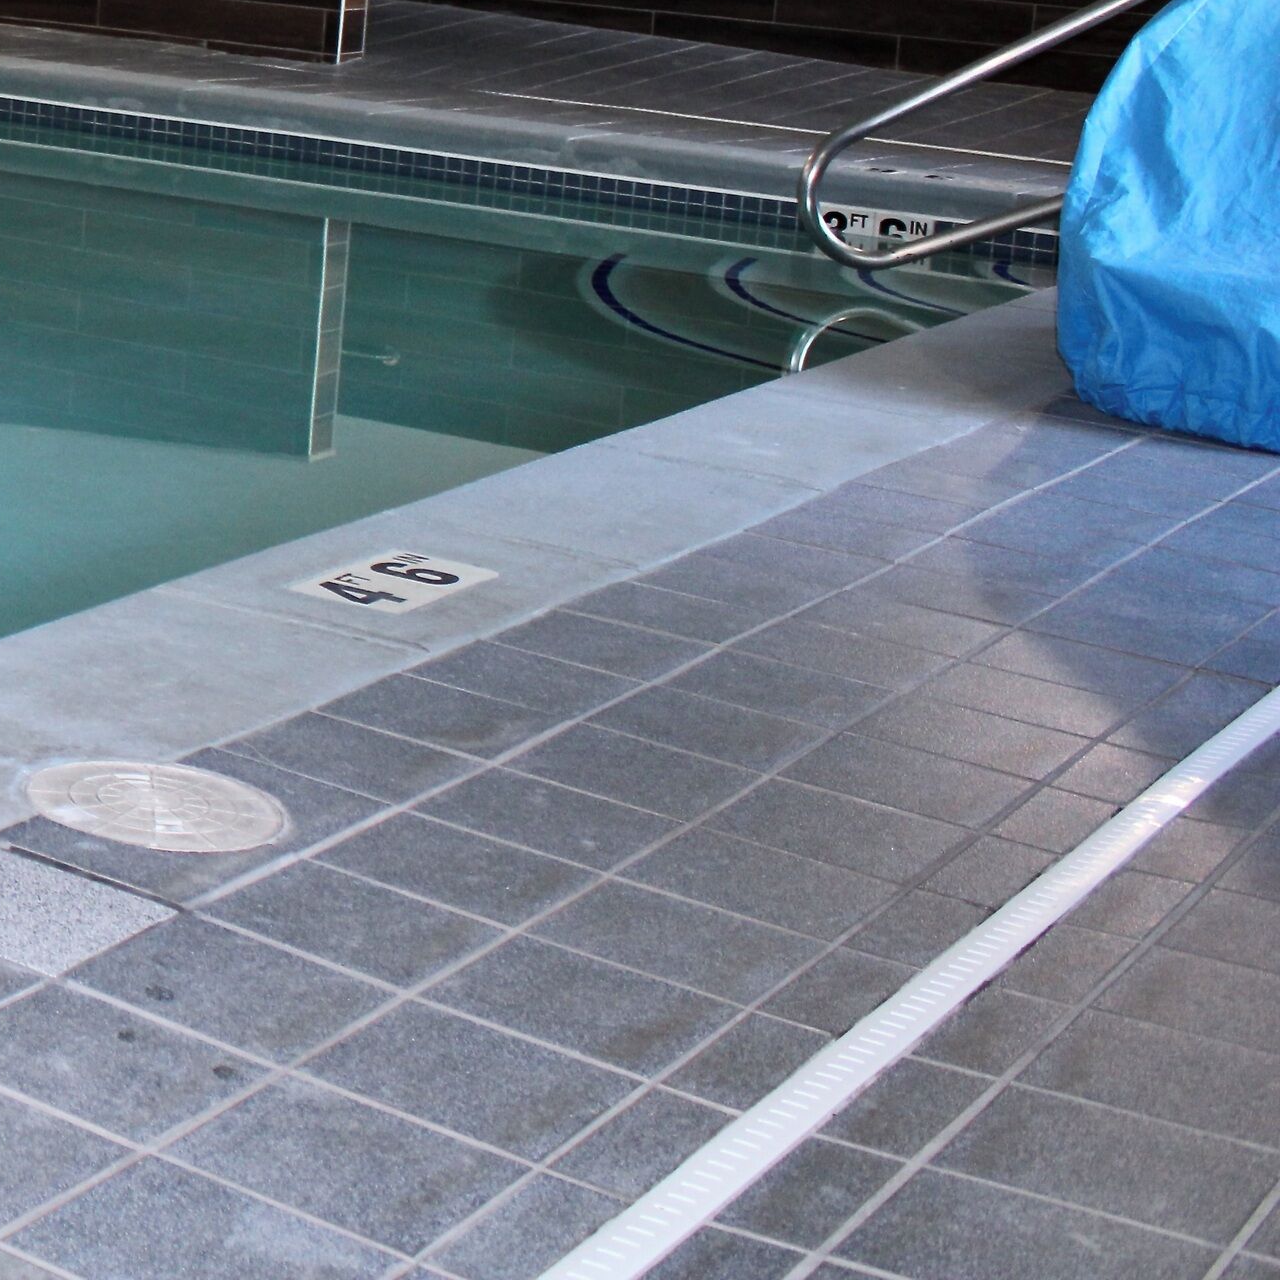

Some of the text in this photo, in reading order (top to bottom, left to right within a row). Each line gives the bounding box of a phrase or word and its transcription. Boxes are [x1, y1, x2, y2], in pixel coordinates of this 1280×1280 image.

[850, 214, 869, 229] FT
[909, 221, 928, 237] IN
[319, 581, 407, 605] 4
[370, 562, 460, 585] 6
